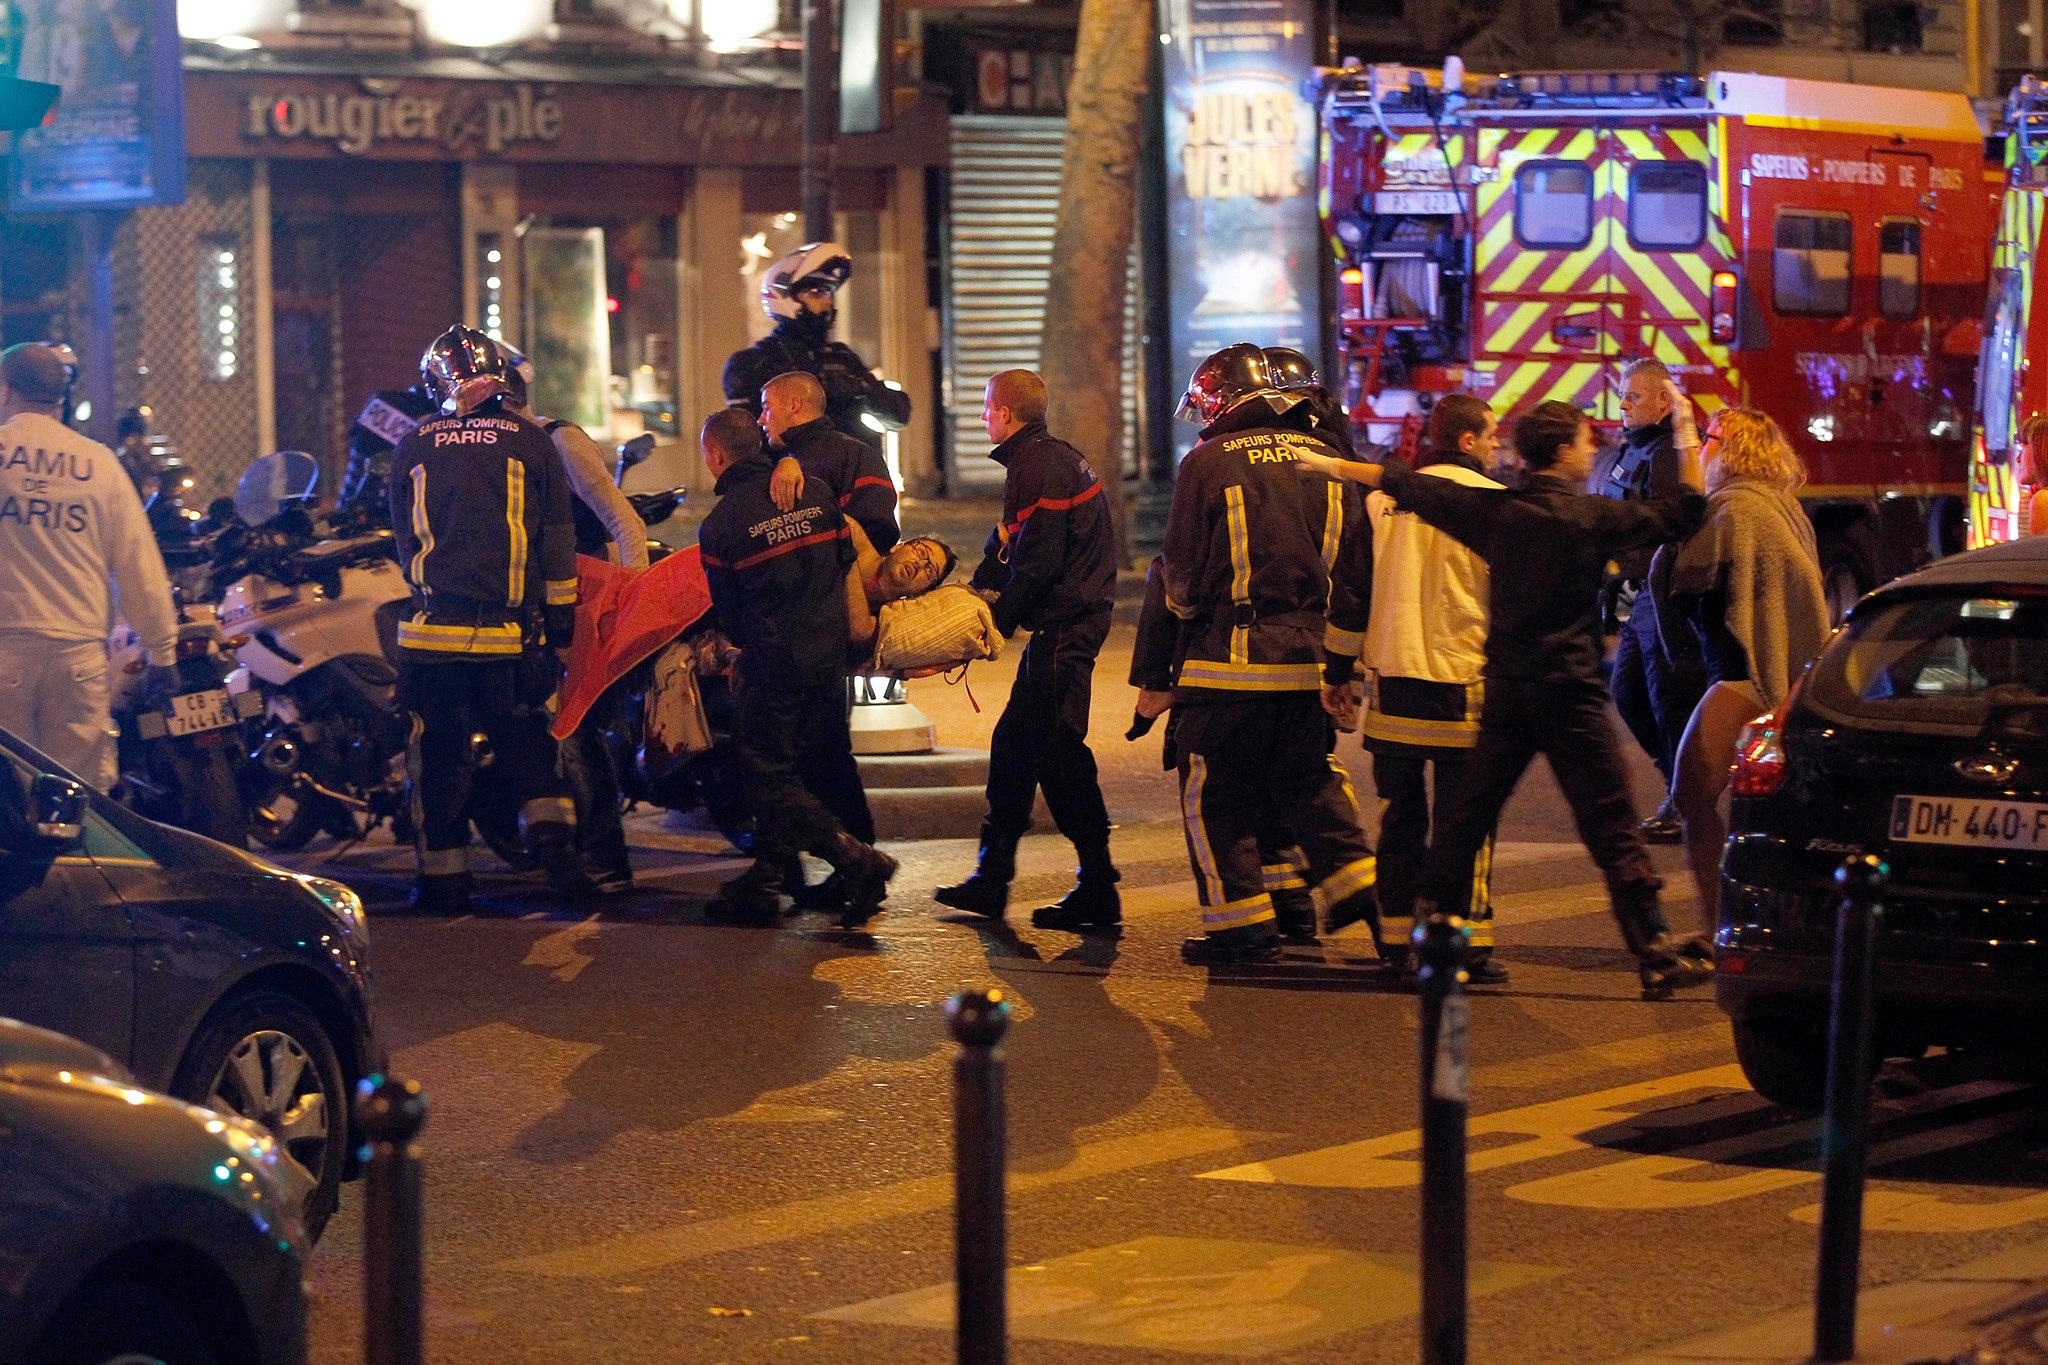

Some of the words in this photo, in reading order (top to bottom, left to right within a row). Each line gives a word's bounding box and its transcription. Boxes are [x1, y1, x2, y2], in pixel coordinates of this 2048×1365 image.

[249, 94, 443, 155] rougier
[1187, 91, 1298, 145] JULES
[1751, 152, 1809, 180] SAPEURS
[1822, 158, 1886, 186] POMPIERS
[1928, 166, 1964, 190] PARIS
[417, 418, 464, 437] SAPEURS
[465, 417, 521, 433] POMPIERS
[434, 430, 499, 448] PARIS
[1222, 434, 1273, 452] SAPEURS
[1273, 433, 1327, 447] POMPIERS
[0, 443, 93, 481] AMU
[21, 477, 49, 494] DE
[748, 517, 784, 538] SAPEURS
[782, 506, 823, 525] POMPIERS
[766, 520, 812, 545] PARIS
